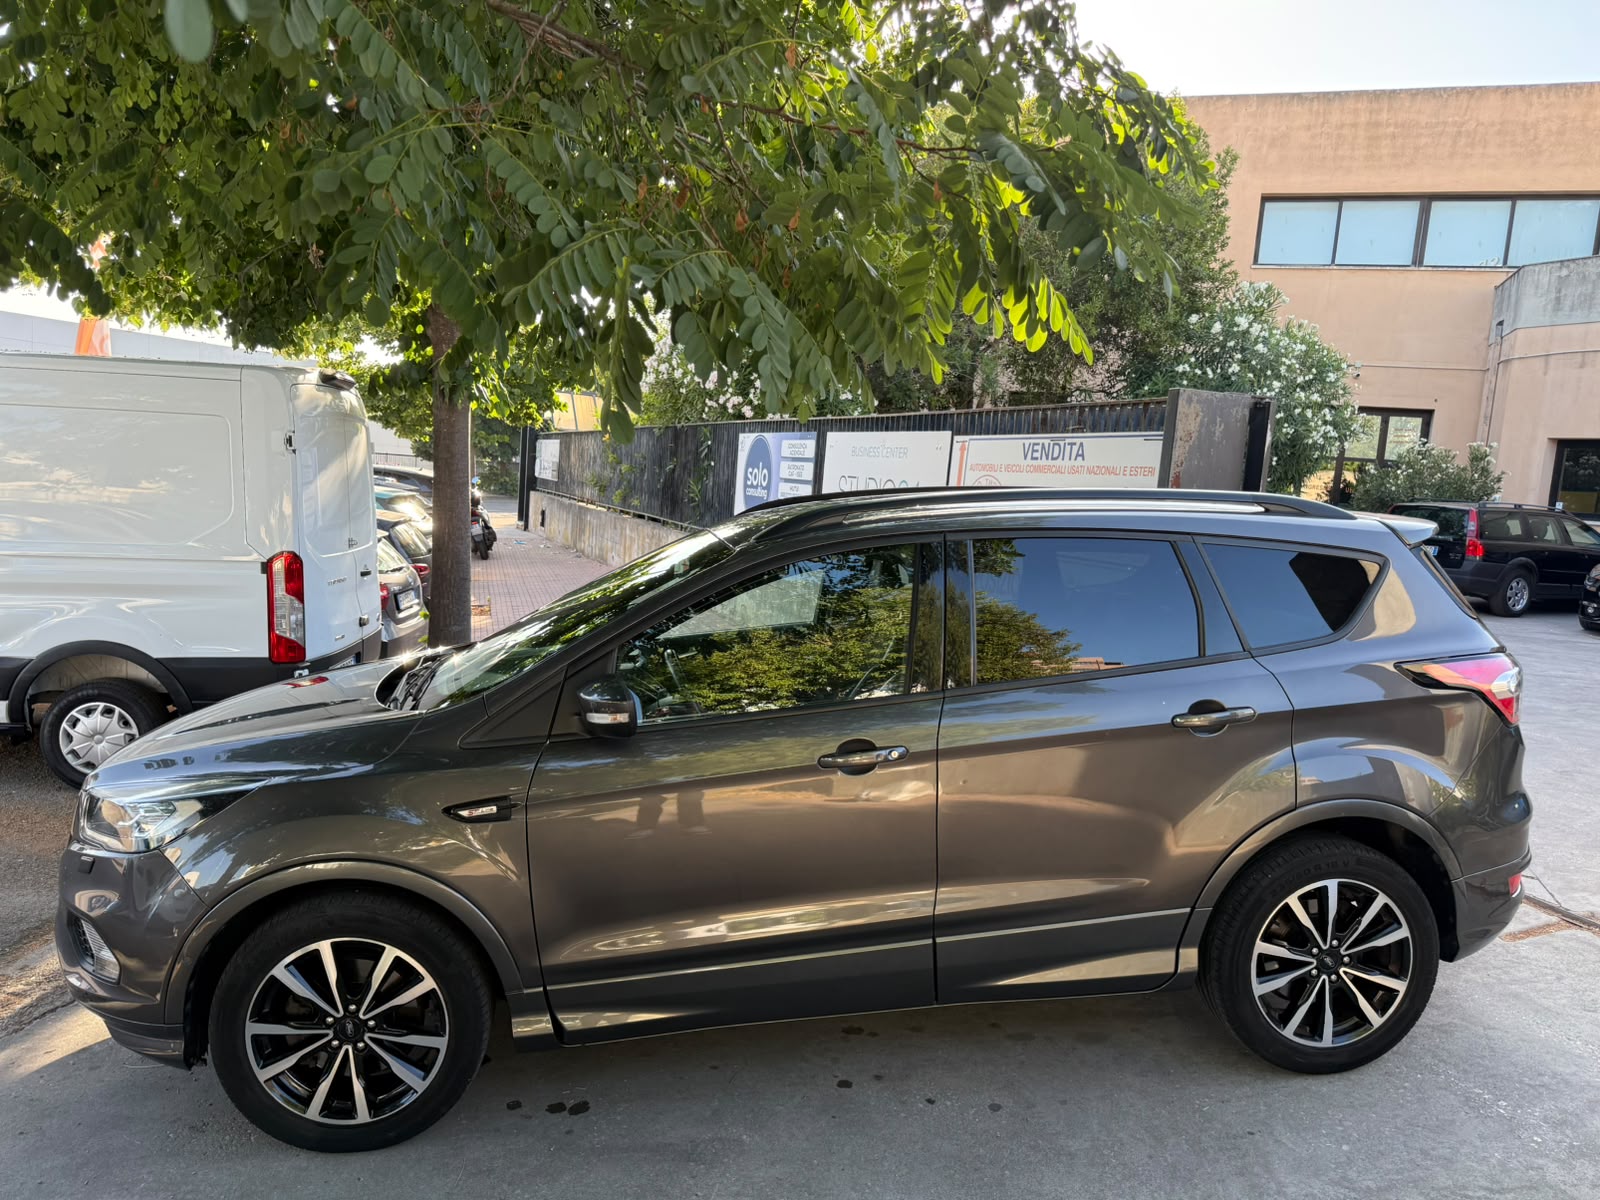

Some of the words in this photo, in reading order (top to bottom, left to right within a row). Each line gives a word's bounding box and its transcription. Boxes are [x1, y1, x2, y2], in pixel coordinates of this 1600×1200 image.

[851, 445, 880, 458] BUSINESS
[881, 446, 909, 459] CENTER
[1022, 442, 1086, 462] VENDITA
[746, 461, 769, 488] solo
[969, 463, 998, 473] AUTOMOBILI
[1025, 464, 1066, 475] COMMERCIALI
[1067, 465, 1085, 475] USATI
[1122, 466, 1128, 477] E
[1129, 466, 1157, 477] ESTERI
[745, 486, 768, 500] consulting
